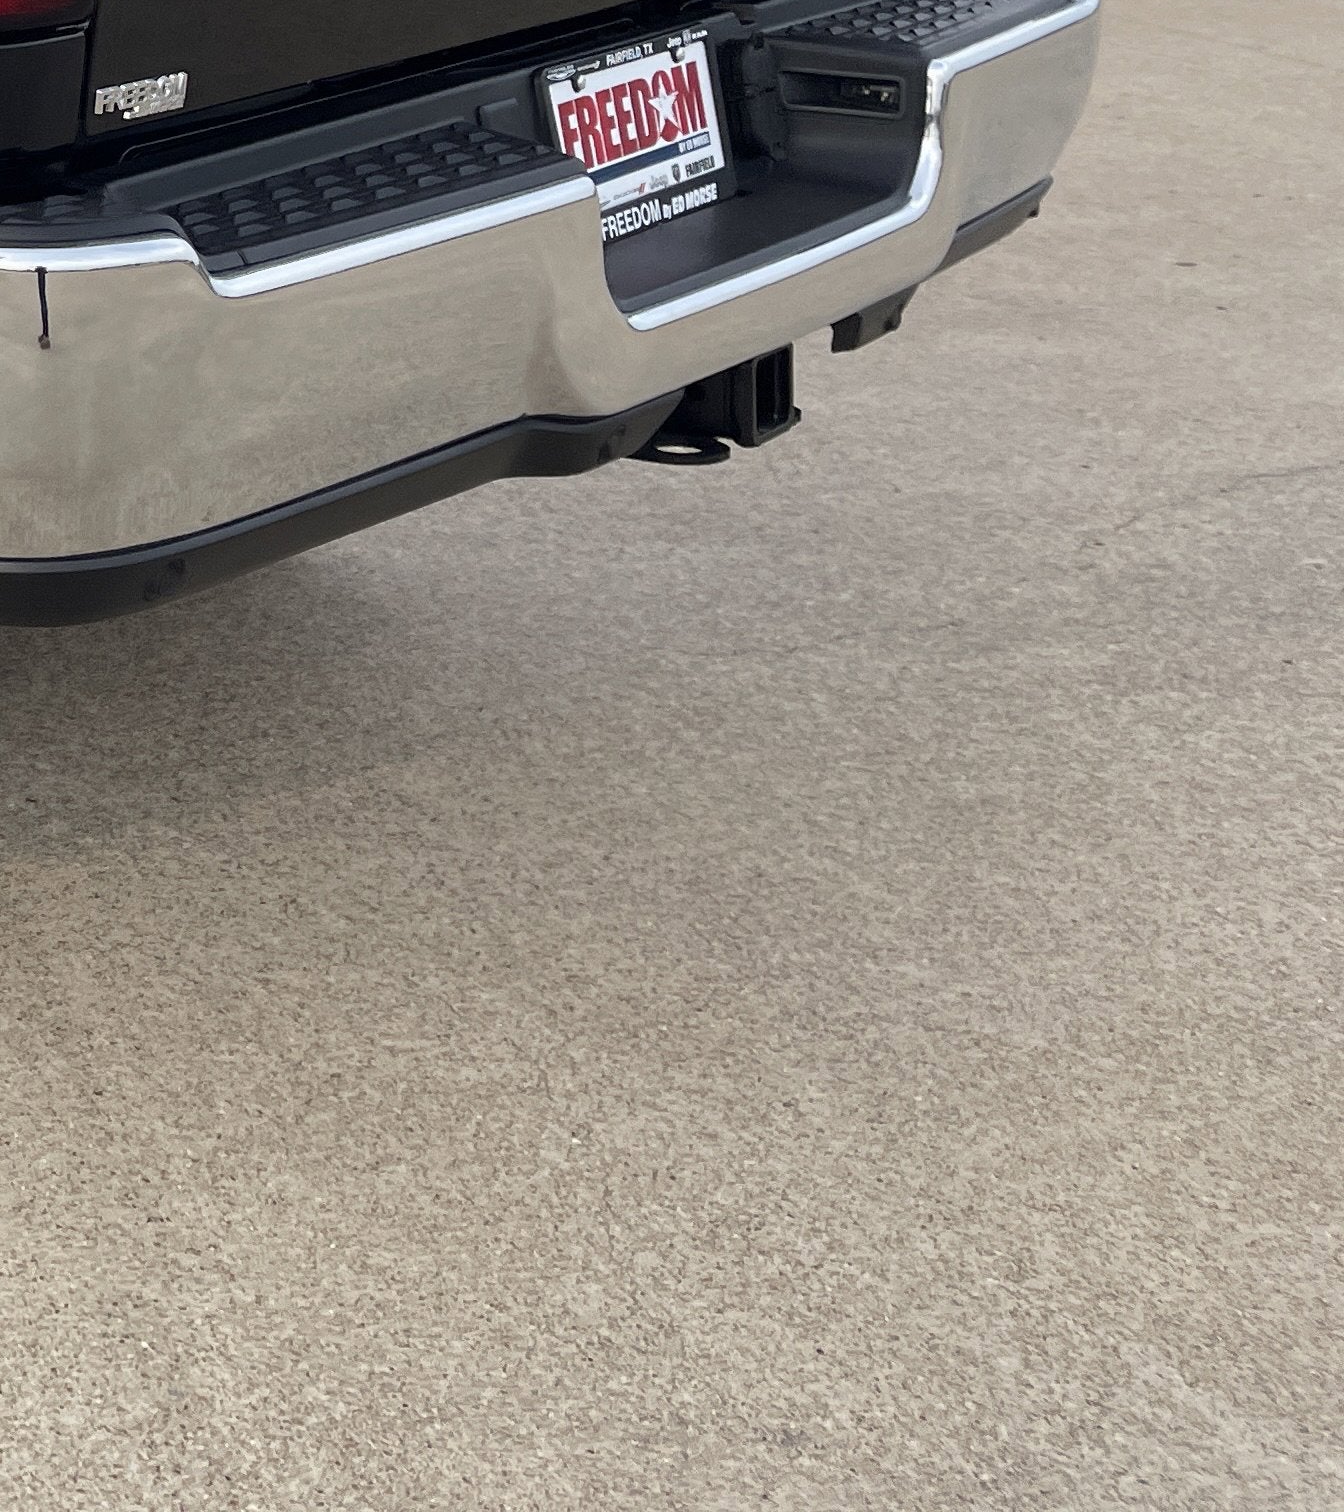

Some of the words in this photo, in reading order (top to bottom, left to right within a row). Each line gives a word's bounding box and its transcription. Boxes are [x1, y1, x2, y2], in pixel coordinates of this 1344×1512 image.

[558, 60, 708, 170] FREEDOM
[601, 198, 662, 242] FREEDOM
[671, 194, 686, 216] ED
[685, 183, 718, 211] MORSE
